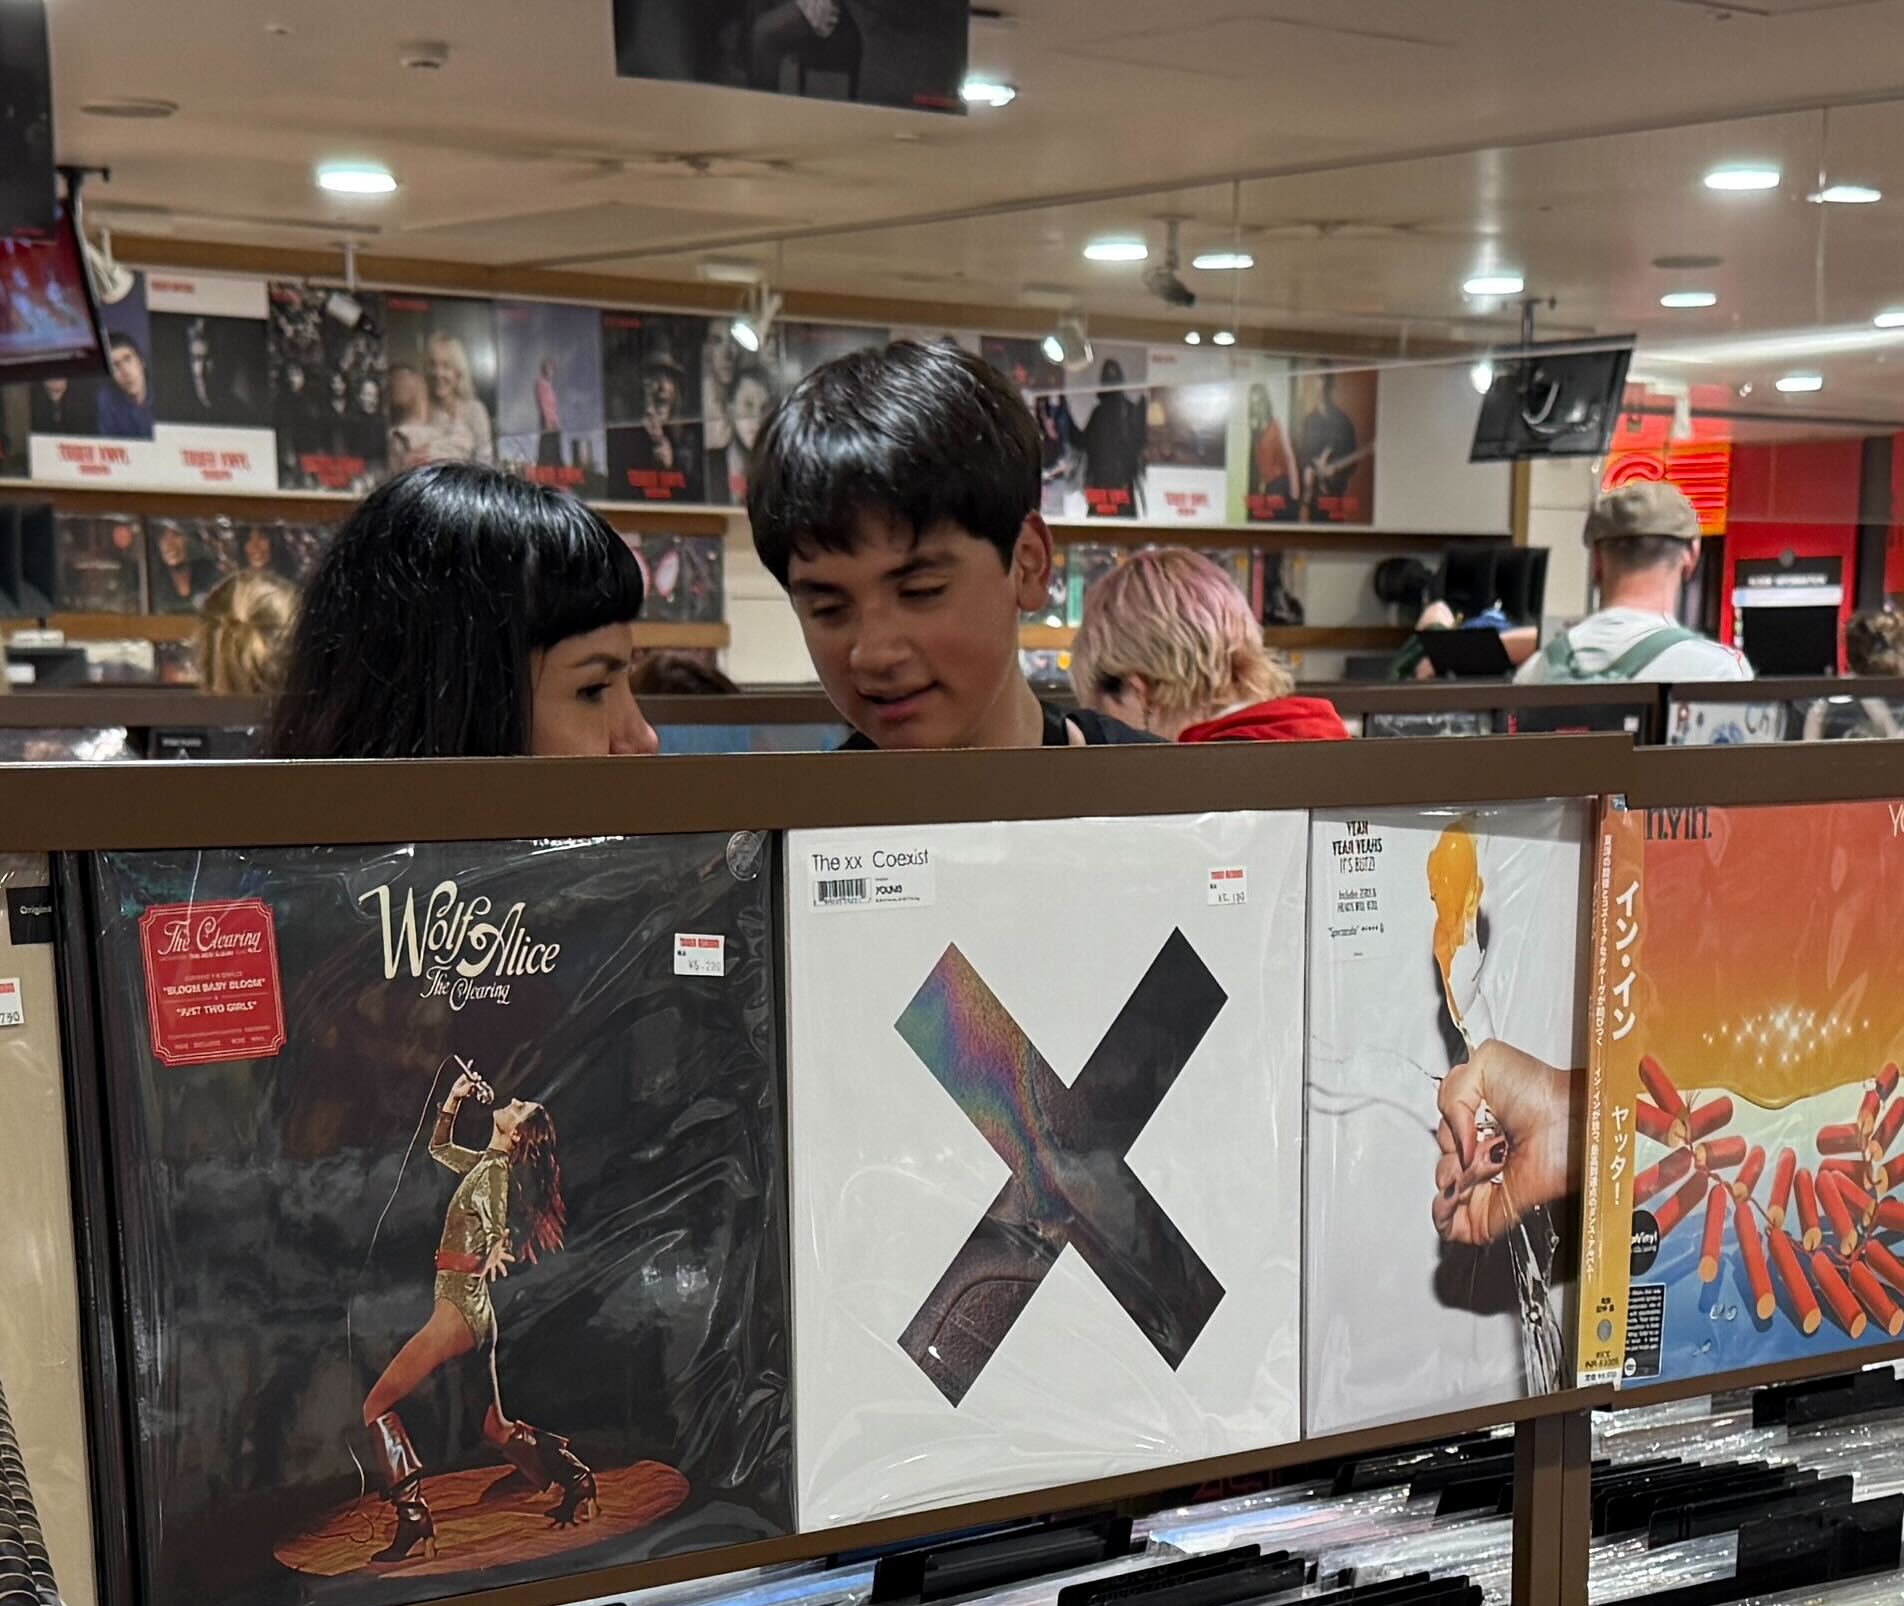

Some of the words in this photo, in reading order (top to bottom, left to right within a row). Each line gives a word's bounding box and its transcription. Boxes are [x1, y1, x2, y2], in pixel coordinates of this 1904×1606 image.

[812, 853, 841, 872] The
[844, 855, 863, 870] xx
[872, 848, 928, 869] Coexist
[359, 881, 492, 980] Wolf
[456, 901, 560, 979] Alice
[1613, 880, 1639, 1041] イン・イン
[420, 963, 450, 1000] The
[450, 977, 511, 1011] Clearing
